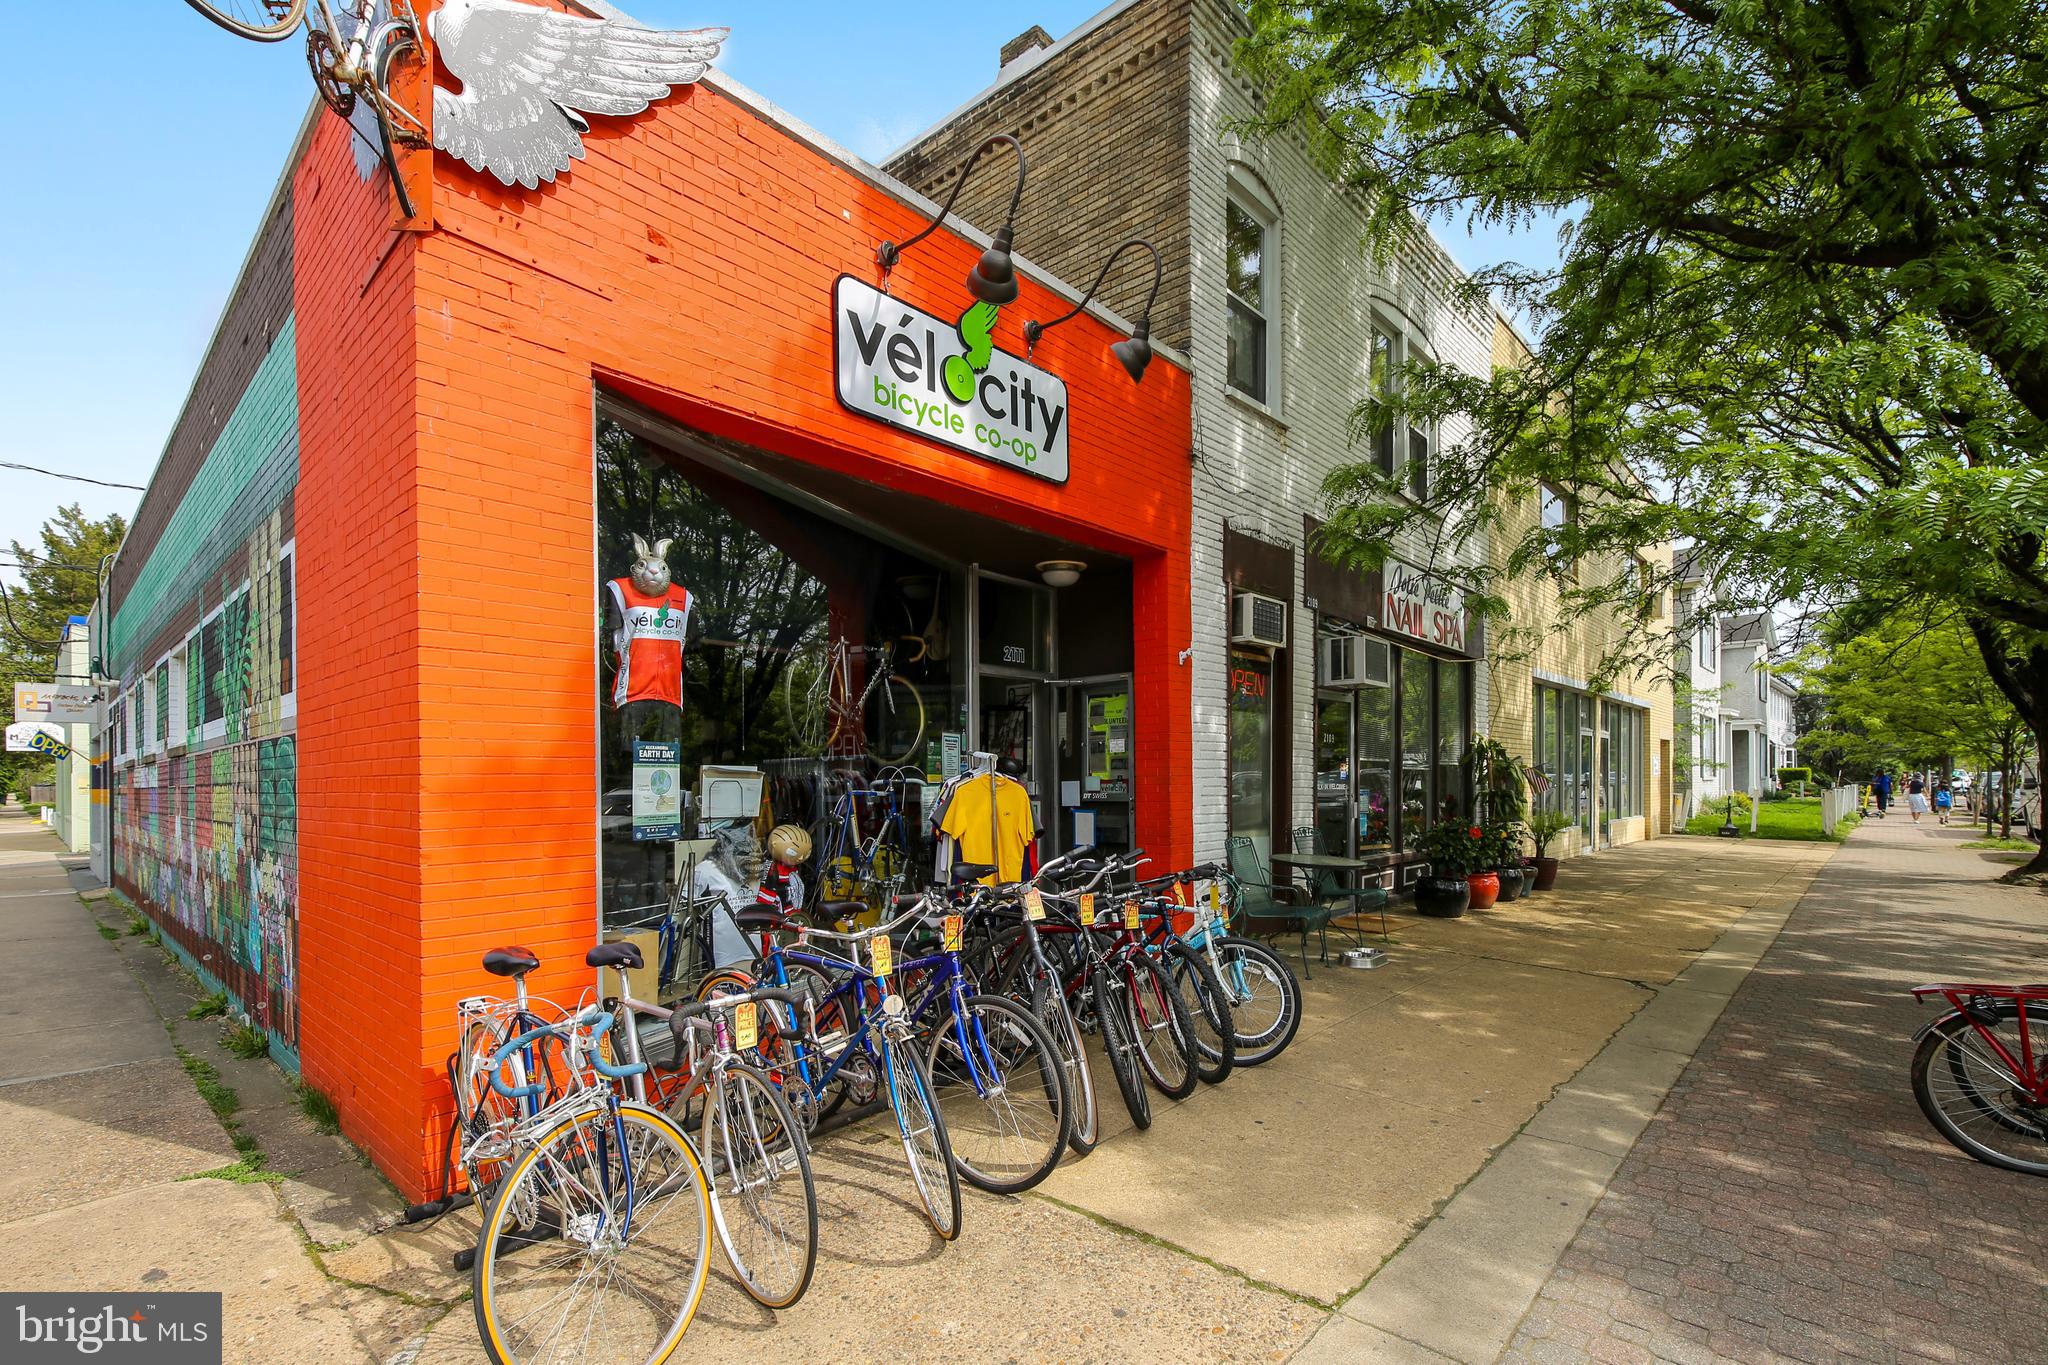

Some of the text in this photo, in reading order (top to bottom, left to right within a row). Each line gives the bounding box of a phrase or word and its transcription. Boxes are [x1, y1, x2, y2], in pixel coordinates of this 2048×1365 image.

[873, 375, 1037, 465] bicycle co-op
[1386, 592, 1463, 650] NAIL SPA
[1003, 645, 1025, 663] 2111
[31, 733, 69, 758] OPEN
[639, 750, 675, 758] EARTH DAY
[738, 1010, 753, 1020] SALE
